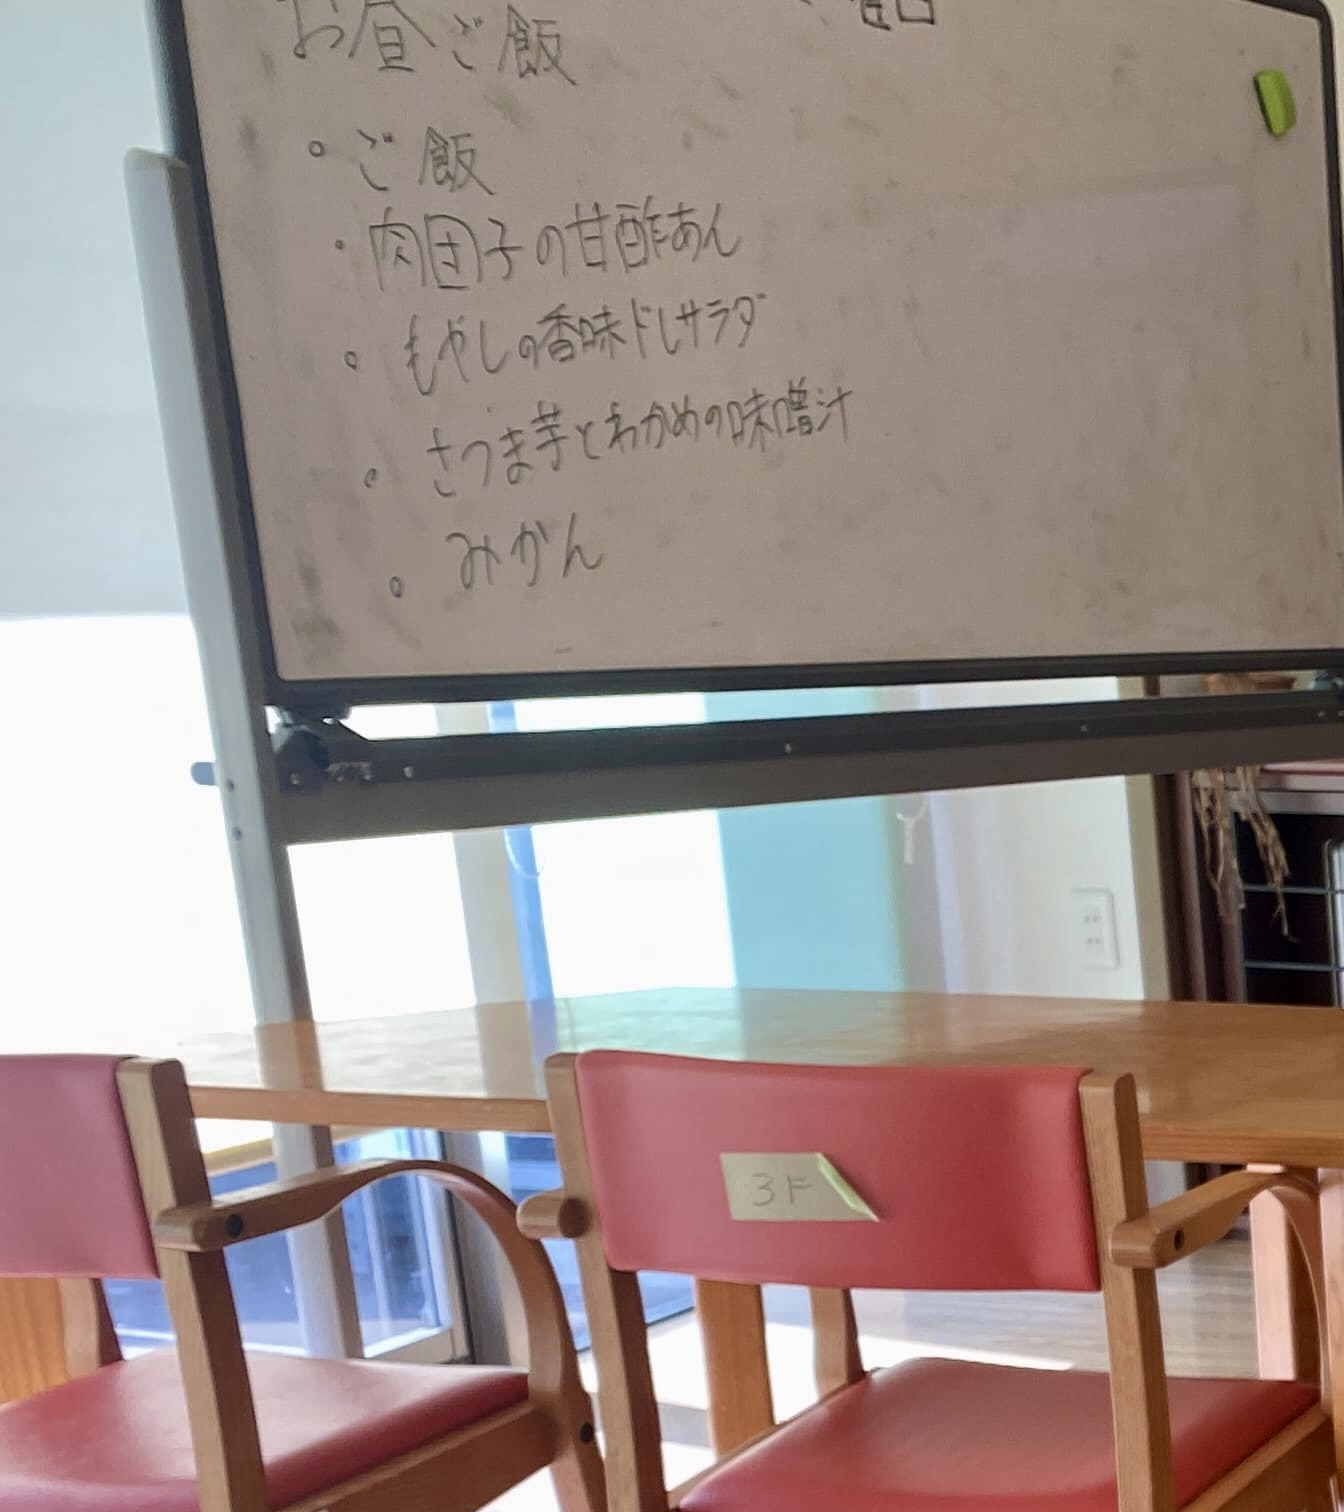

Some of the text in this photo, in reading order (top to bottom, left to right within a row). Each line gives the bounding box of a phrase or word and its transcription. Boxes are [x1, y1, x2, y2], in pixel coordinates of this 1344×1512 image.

[356, 126, 496, 196] ご飯
[368, 195, 742, 292] 肉団子の甘酢あん
[445, 512, 604, 590] みかん
[752, 1172, 813, 1207] 3F
